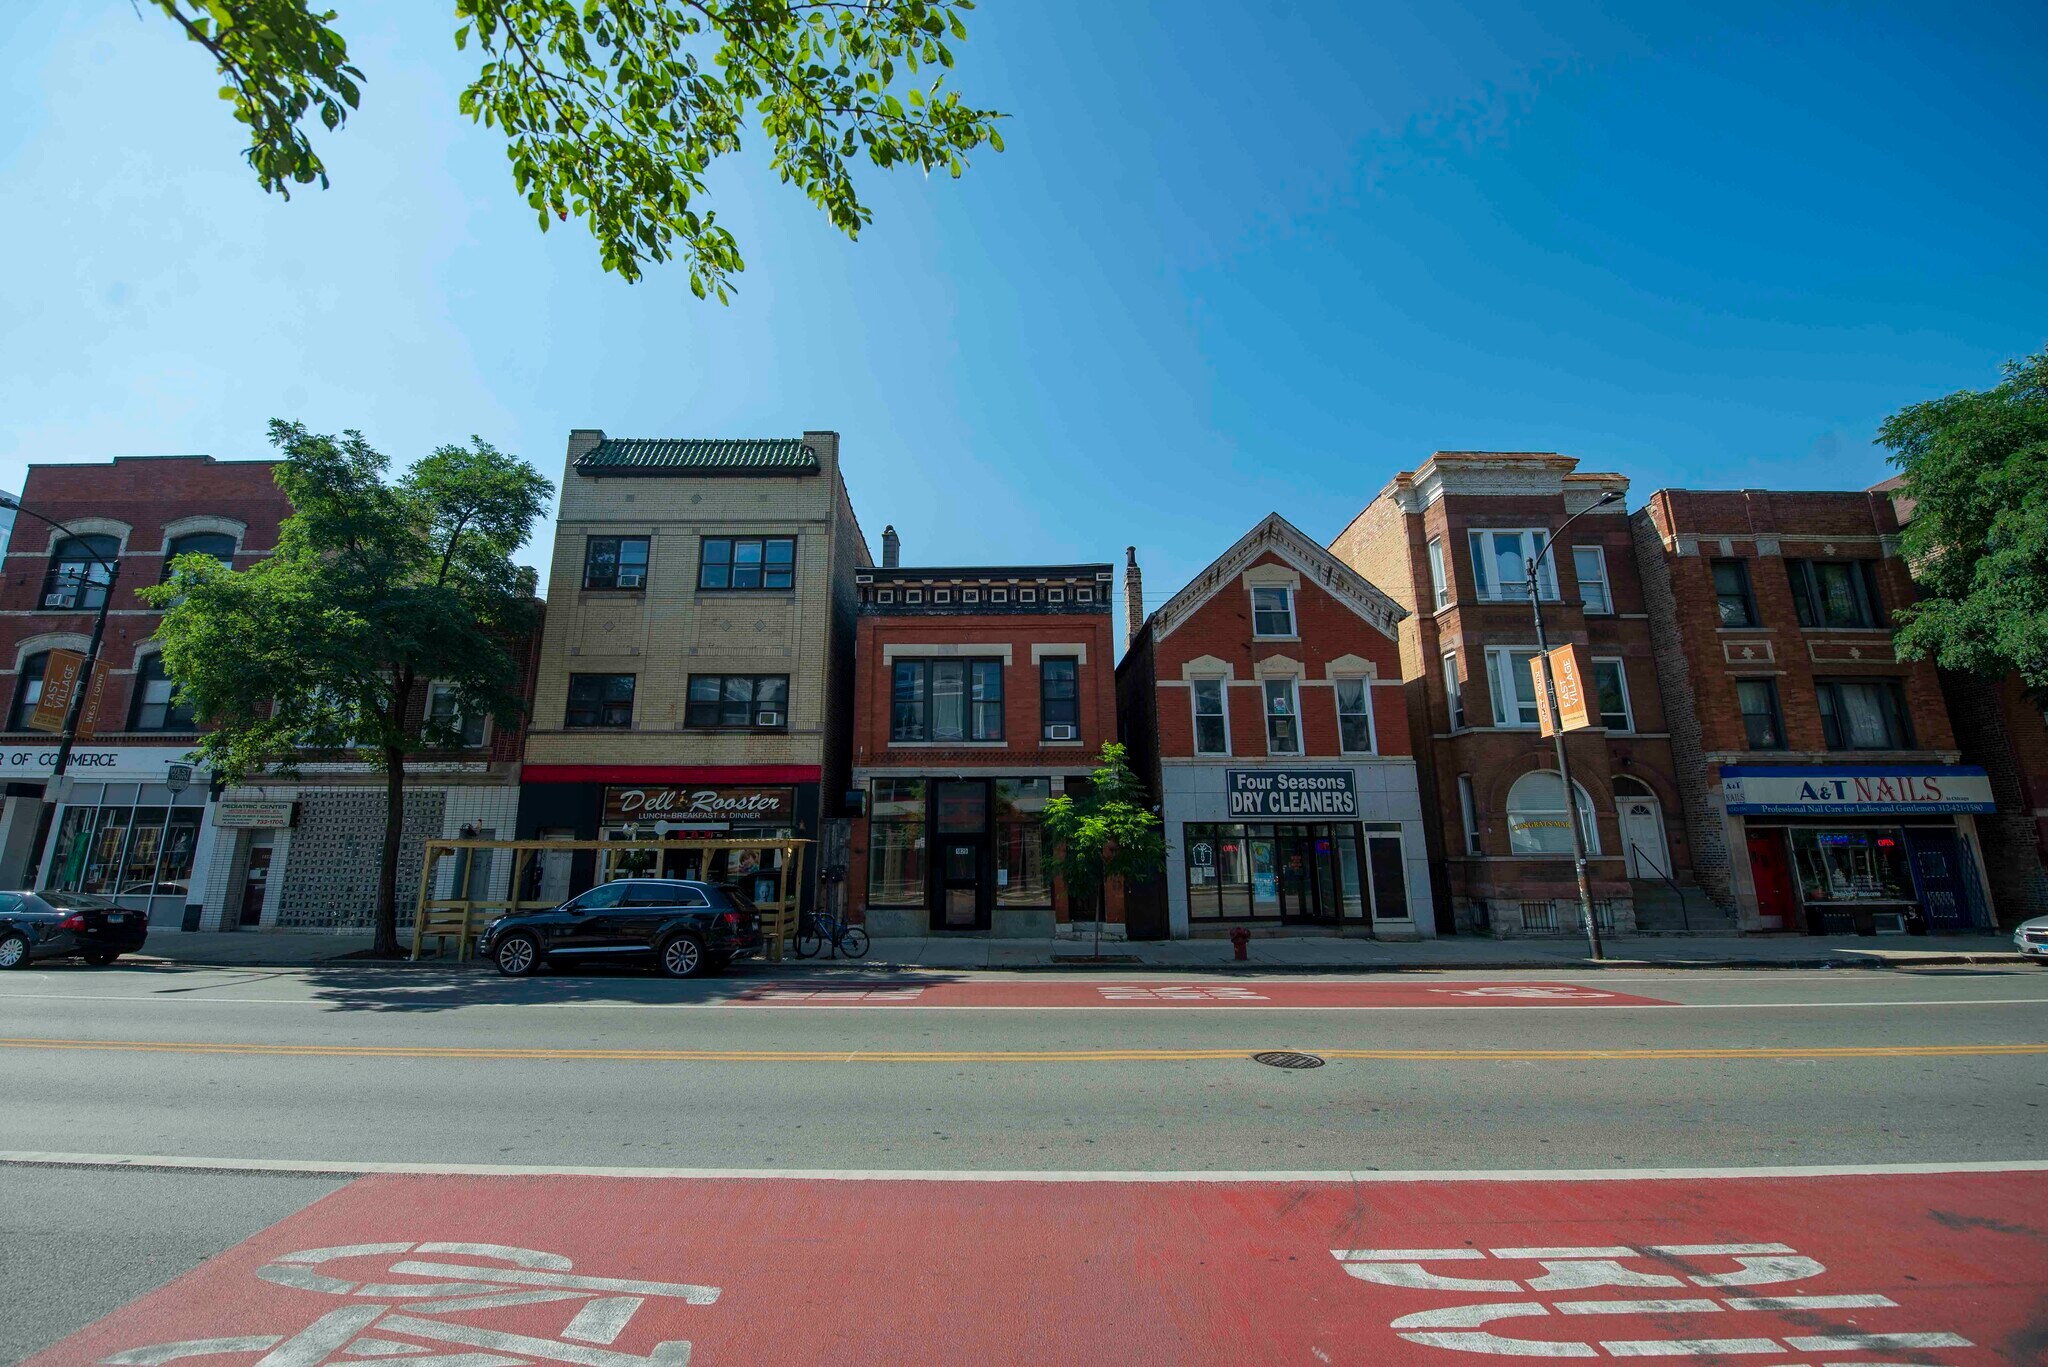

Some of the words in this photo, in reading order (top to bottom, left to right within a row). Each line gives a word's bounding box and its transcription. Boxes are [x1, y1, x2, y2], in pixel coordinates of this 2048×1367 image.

[44, 678, 60, 708] EAST
[54, 664, 75, 709] VILLAGE
[1563, 658, 1579, 706] VILLAGE
[85, 701, 97, 723] WEST
[93, 673, 105, 697] TOWN
[1559, 680, 1571, 709] EAST
[11, 752, 33, 766] OF
[38, 753, 118, 767] COMERCE
[170, 766, 192, 775] WEST
[171, 773, 189, 781] TOWN
[1236, 774, 1273, 790] Four
[1277, 773, 1346, 790] Seasons
[1800, 780, 1848, 801] A&T
[1853, 776, 1943, 802] NAILS
[690, 790, 780, 812] Rooster
[1231, 791, 1264, 813] DRY
[1268, 791, 1355, 813] CLEANERS
[1761, 804, 1806, 813] Professional
[1807, 804, 1823, 813] Nail
[1824, 804, 1841, 813] Care
[1843, 804, 1855, 813] for
[1856, 804, 1880, 813] Ladies
[1880, 804, 1895, 812] and
[1896, 804, 1936, 812] Gentlemen
[1937, 803, 1983, 812] 312-421-1580
[1329, 1242, 1977, 1367] BU
